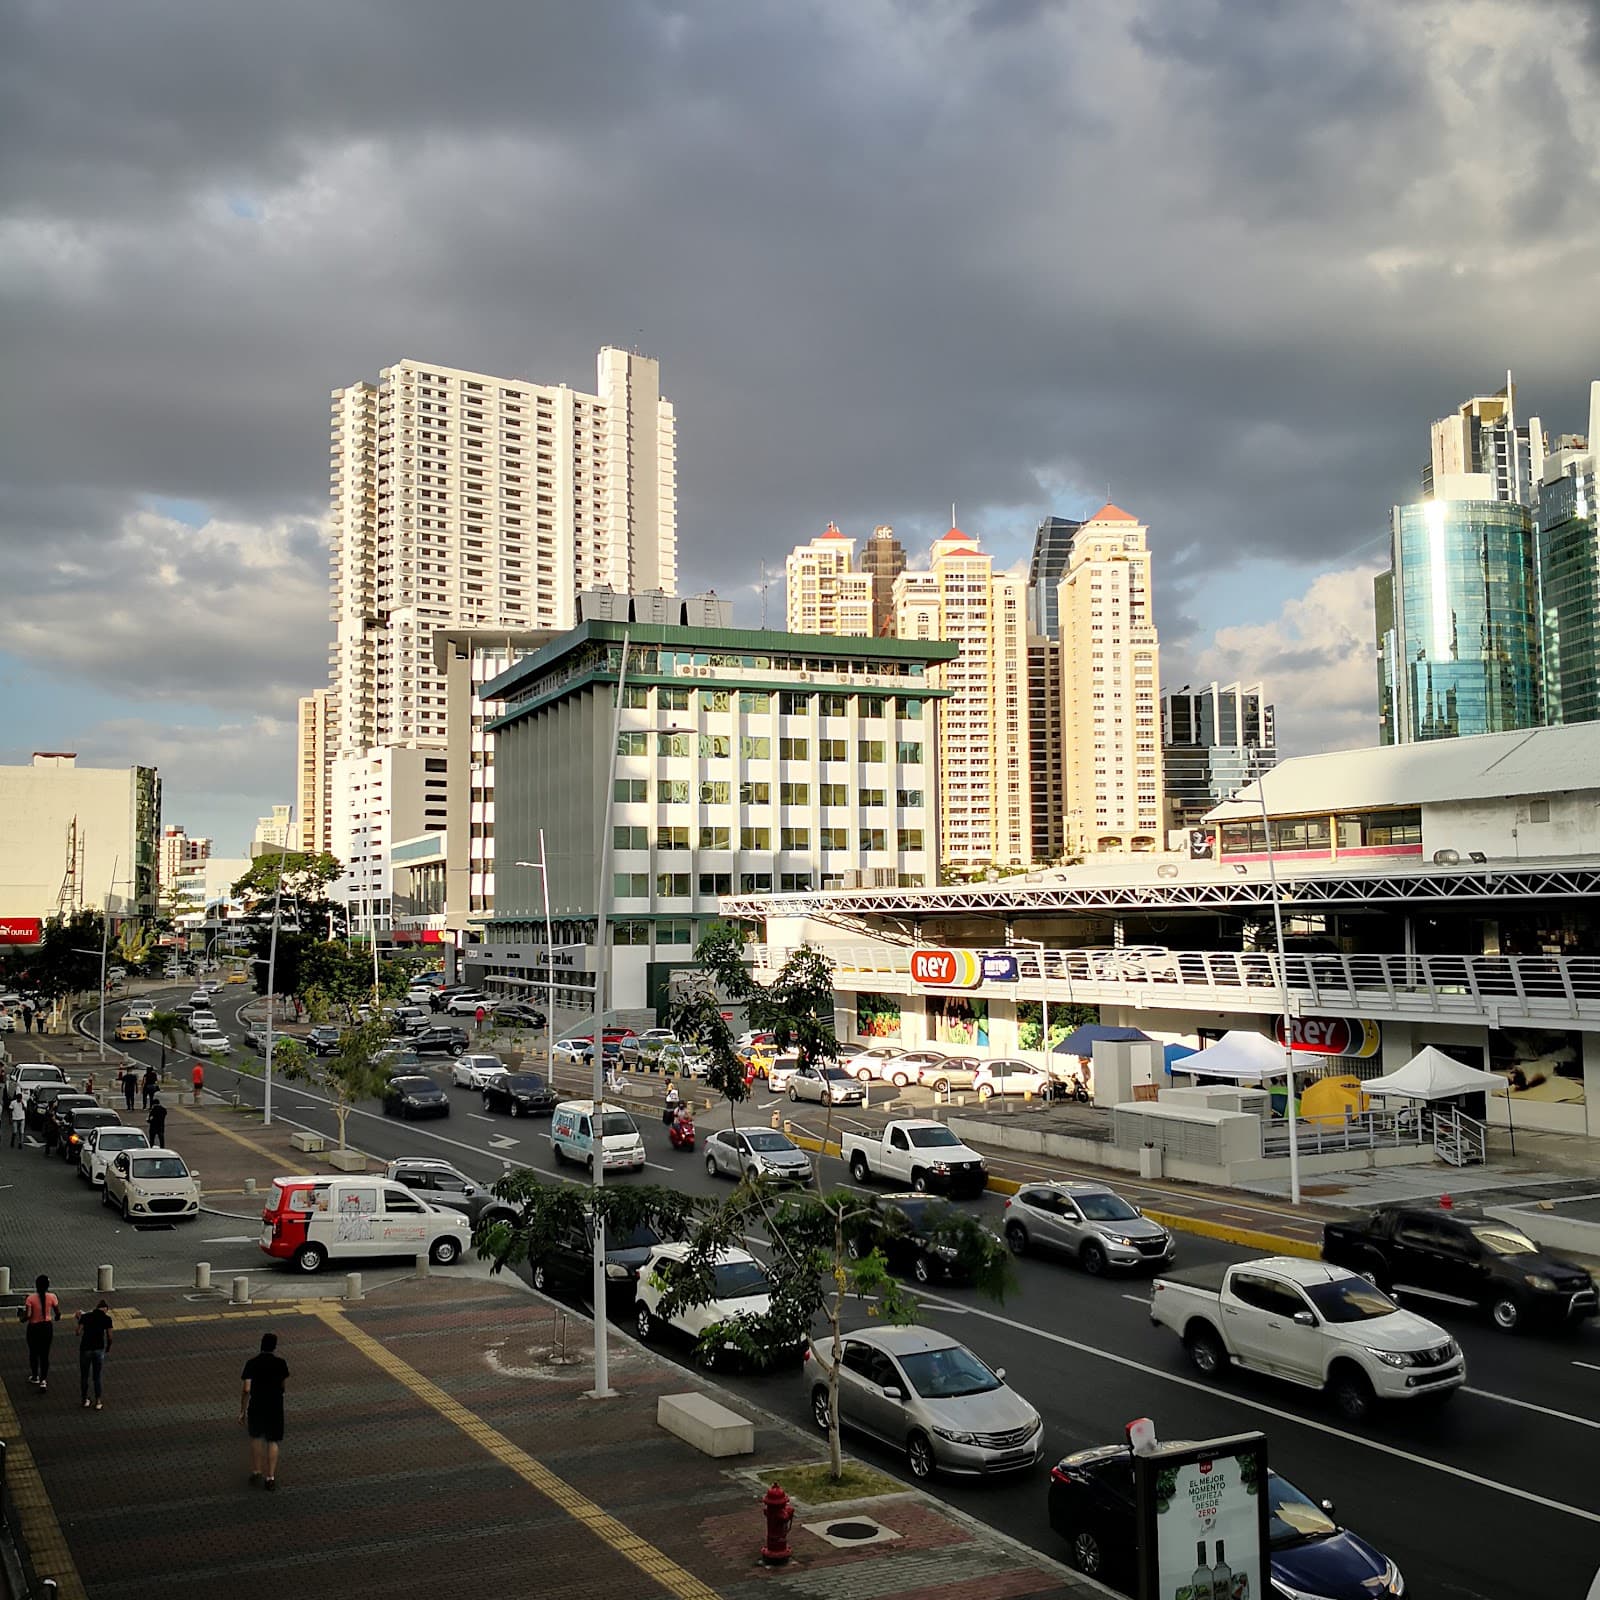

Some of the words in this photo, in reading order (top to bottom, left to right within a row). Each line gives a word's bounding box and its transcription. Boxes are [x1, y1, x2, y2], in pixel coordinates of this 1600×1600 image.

[1200, 1475, 1224, 1486] MEJOR
[1188, 1482, 1226, 1496] MOMENTO
[1192, 1490, 1222, 1502] EMPIEZA
[1195, 1499, 1219, 1510] DESDE
[1198, 1508, 1217, 1517] ZERO
